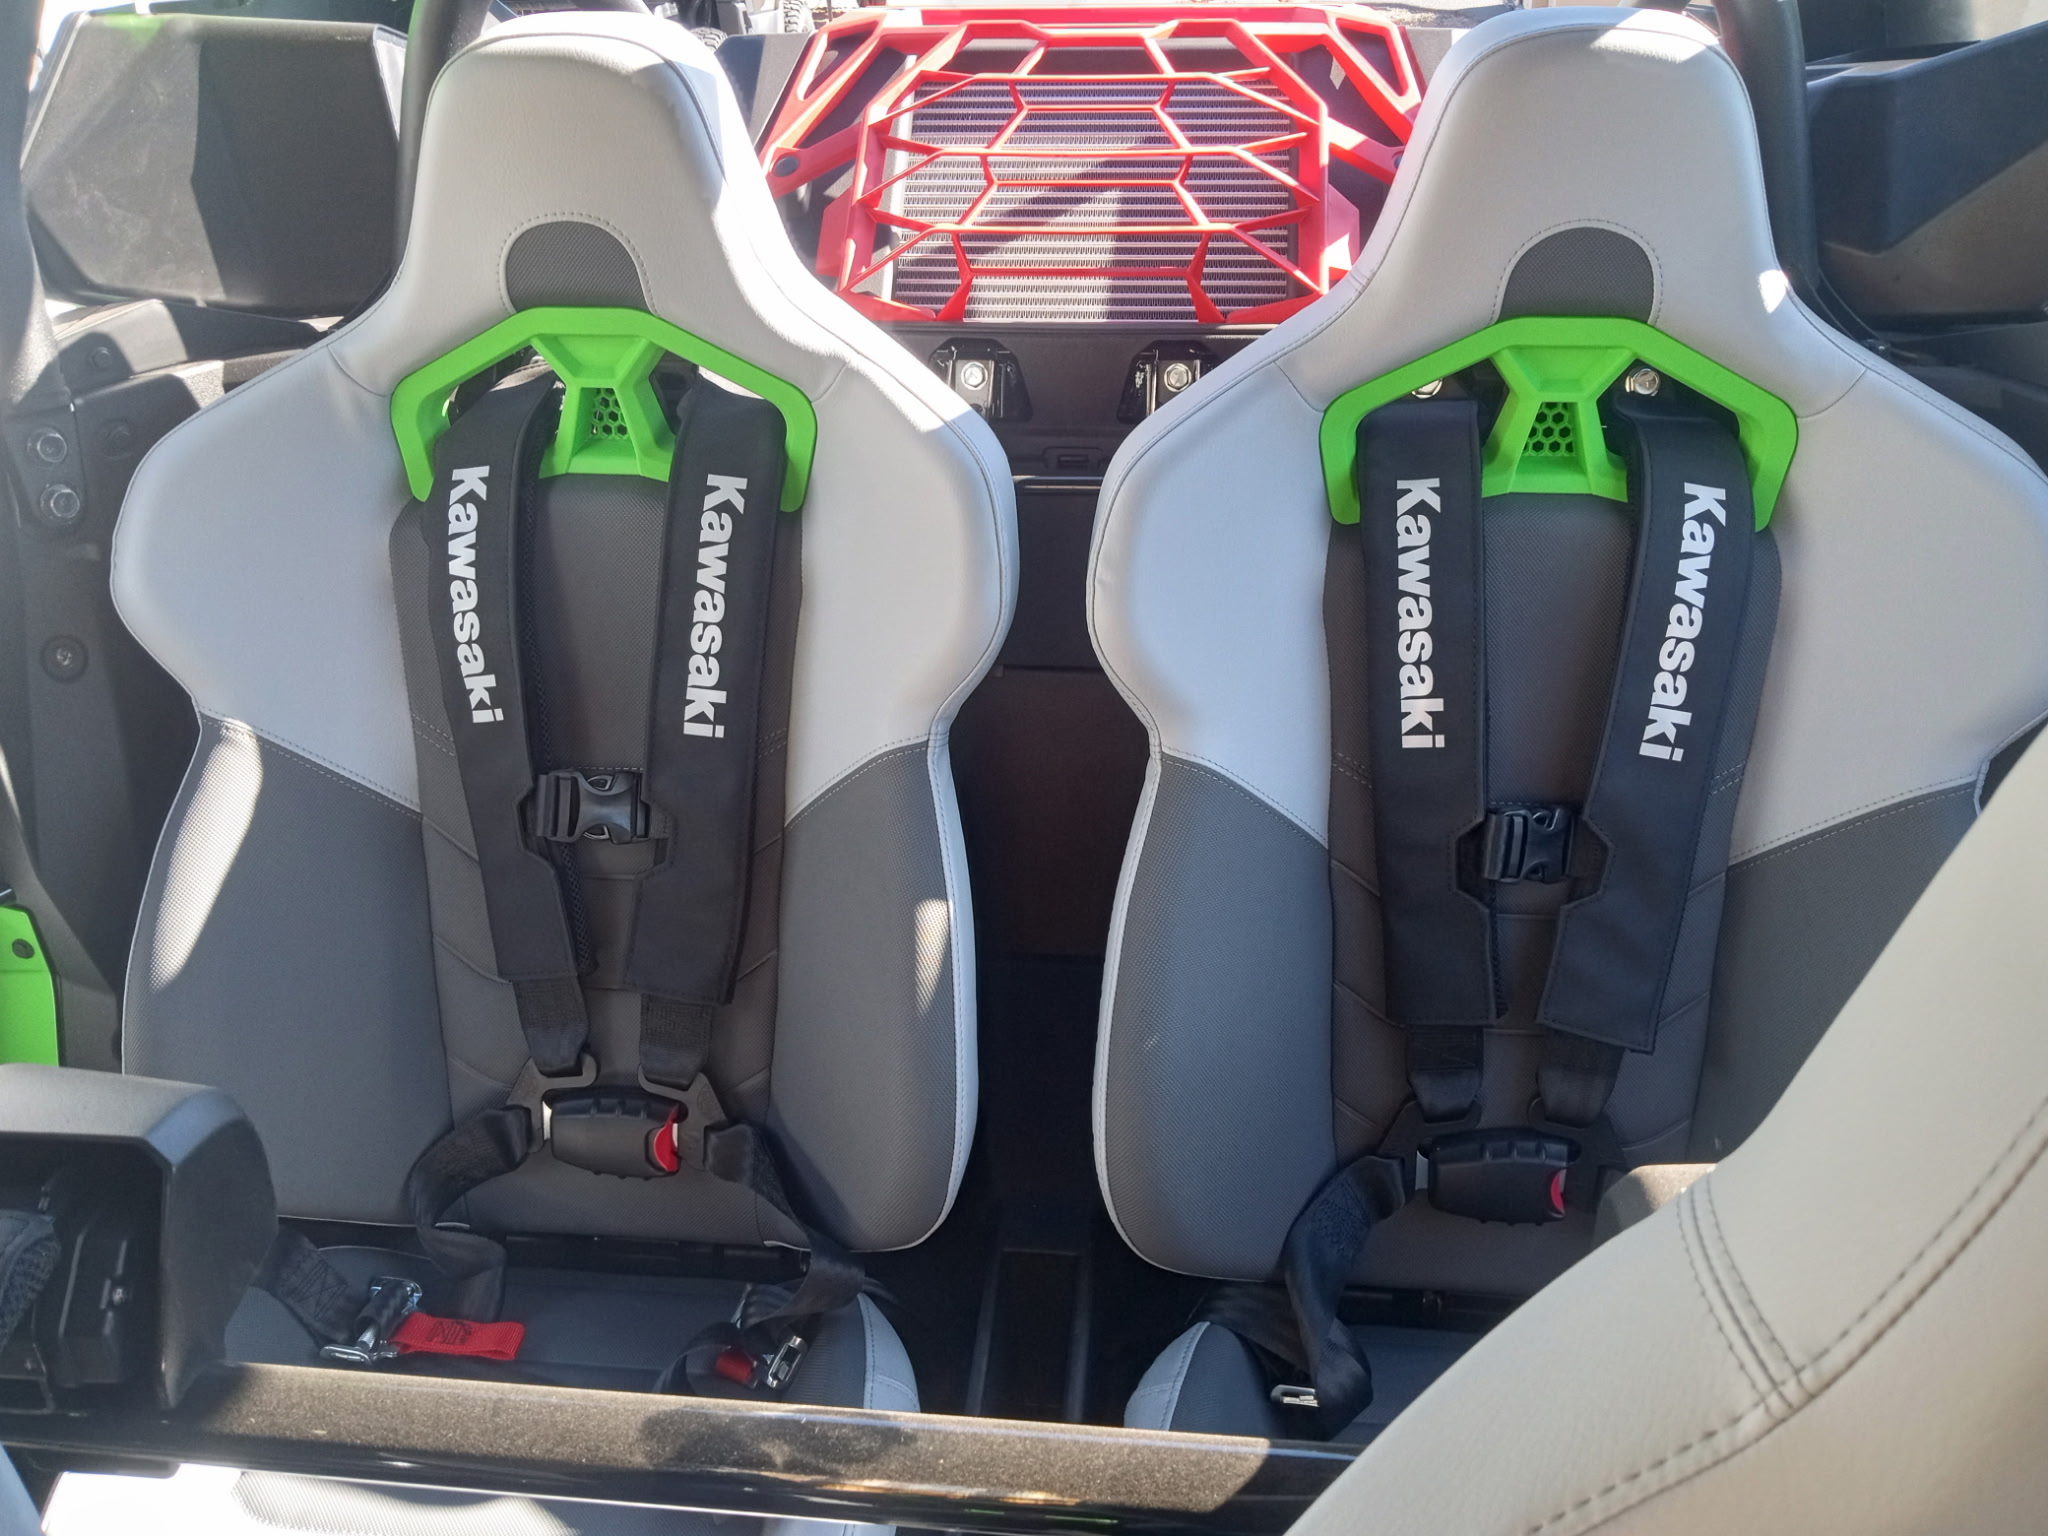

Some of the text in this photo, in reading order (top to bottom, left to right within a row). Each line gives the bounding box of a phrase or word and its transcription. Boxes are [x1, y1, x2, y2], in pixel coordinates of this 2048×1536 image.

[447, 465, 504, 724] Kawasaki
[684, 473, 748, 738] Kawasaki
[1396, 477, 1445, 749] Kawasaki
[1639, 482, 1727, 762] Kawasaki
